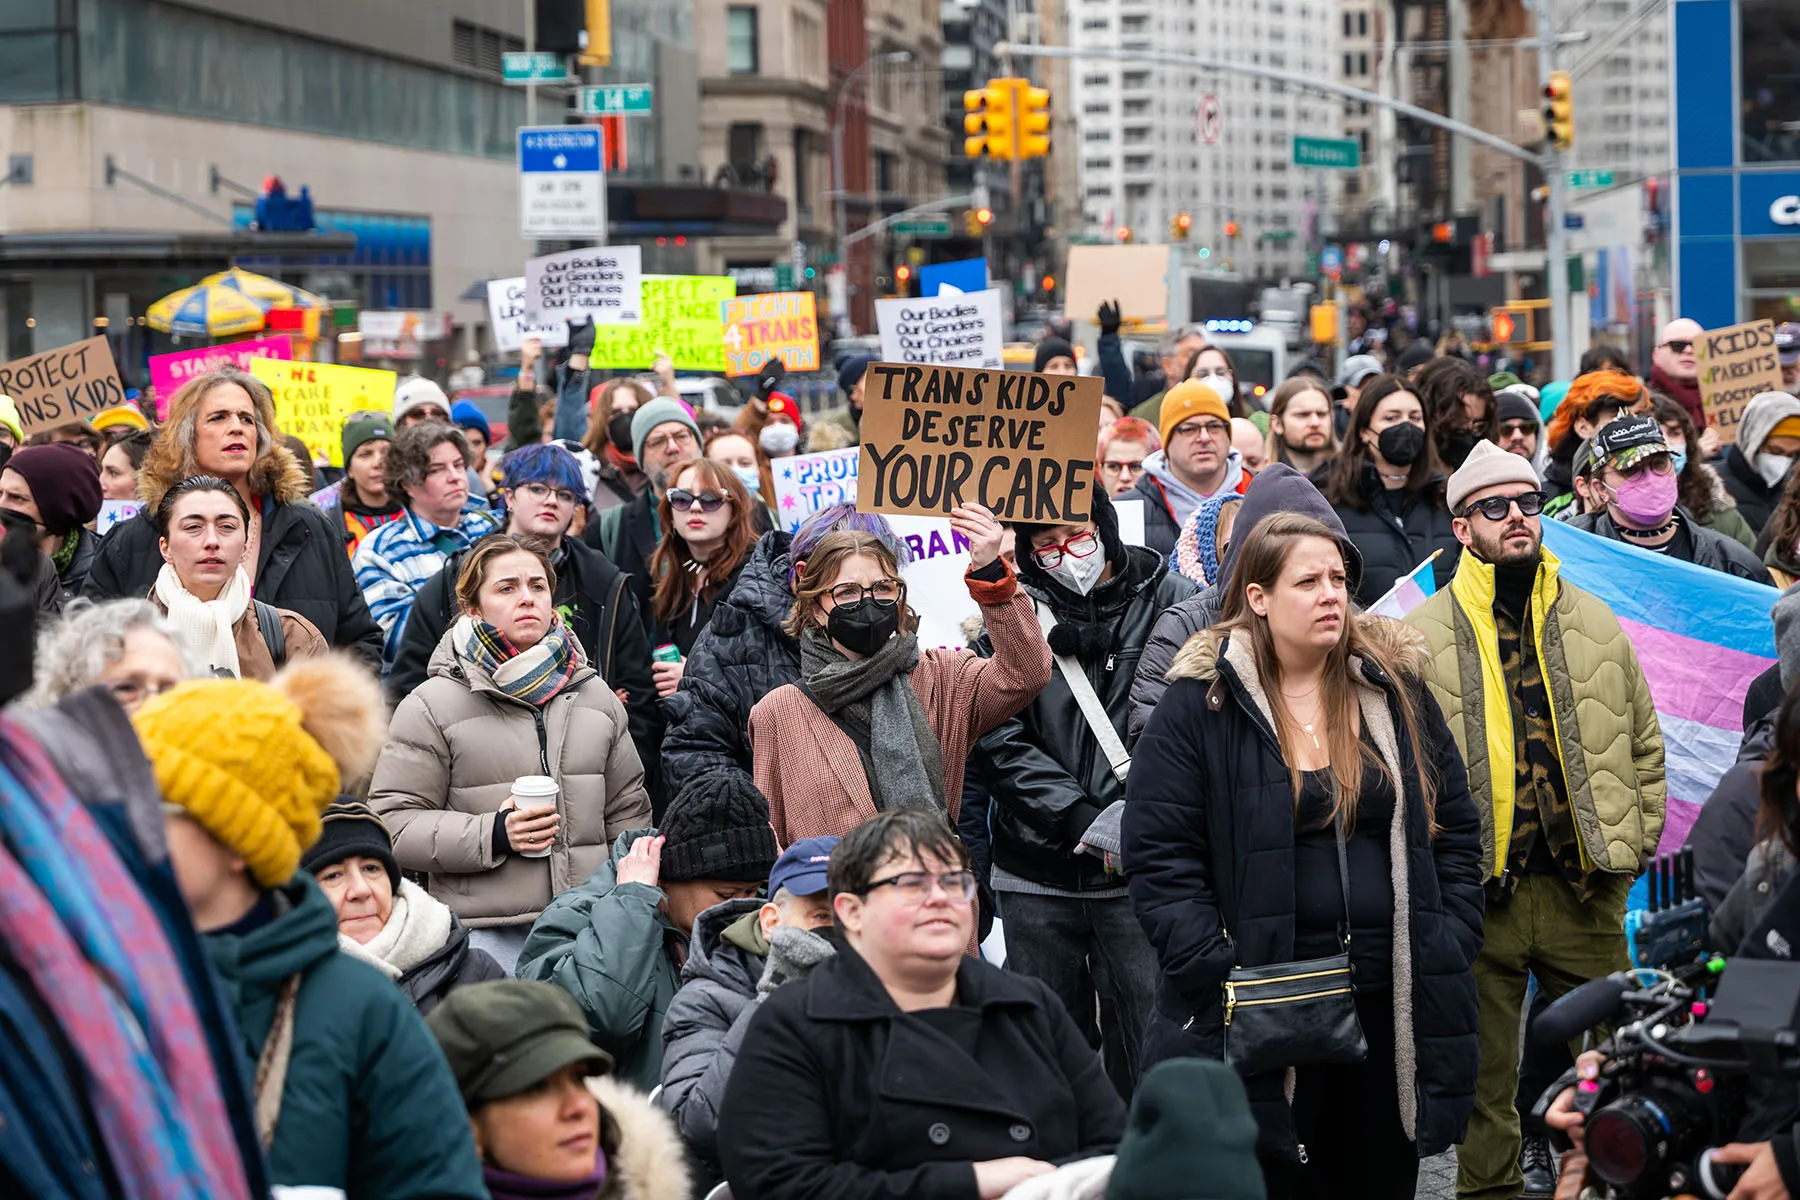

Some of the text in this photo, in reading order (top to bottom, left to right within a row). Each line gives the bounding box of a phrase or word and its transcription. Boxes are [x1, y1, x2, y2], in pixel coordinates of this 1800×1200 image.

[545, 255, 618, 273] Our Bodies
[539, 268, 624, 286] Our Genders
[541, 282, 622, 297] Our Choices
[542, 294, 621, 308] Our Futures
[900, 303, 978, 321] Our Bodies
[723, 316, 813, 351] 4 TRANS
[896, 318, 985, 335] Our Genders
[900, 333, 984, 349] Our Choices
[1707, 322, 1775, 359] KIDS
[728, 345, 813, 373] YOUTH
[903, 349, 927, 363] Our
[930, 347, 983, 363] Futures
[291, 367, 316, 383] WE
[1711, 353, 1776, 383] PARENTS
[66, 375, 122, 417] KIDS
[283, 384, 332, 402] CARE
[874, 366, 1076, 417] TRANS KIDS
[293, 402, 330, 417] FOR
[901, 407, 1046, 451] DESERVE
[864, 443, 1094, 522] YOUR CARE
[902, 527, 971, 564] RAN
